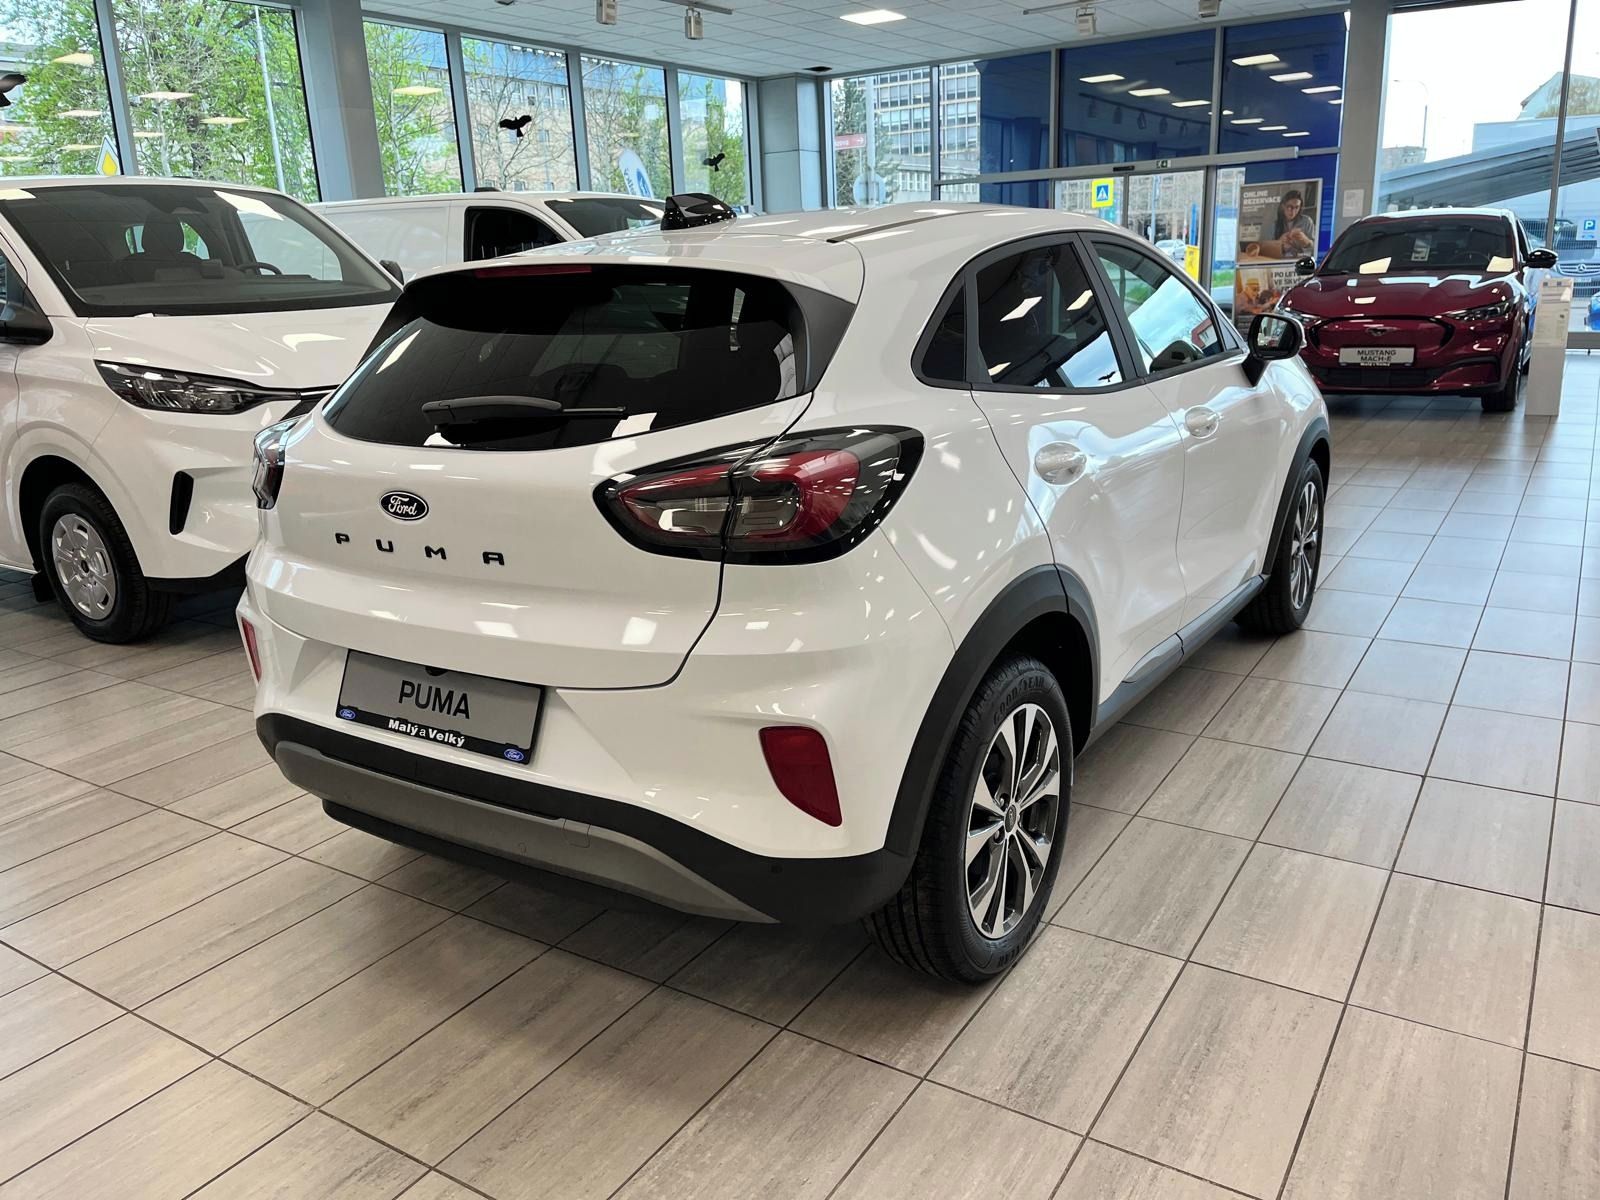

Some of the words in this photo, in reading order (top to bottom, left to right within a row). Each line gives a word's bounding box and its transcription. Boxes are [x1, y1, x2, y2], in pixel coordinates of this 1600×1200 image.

[1243, 190, 1269, 199] ONLINE
[387, 495, 418, 516] Ford
[335, 532, 505, 566] PUMA
[398, 679, 470, 720] PUMA
[388, 719, 419, 736] Malý
[419, 728, 426, 737] a
[428, 728, 465, 747] Velký
